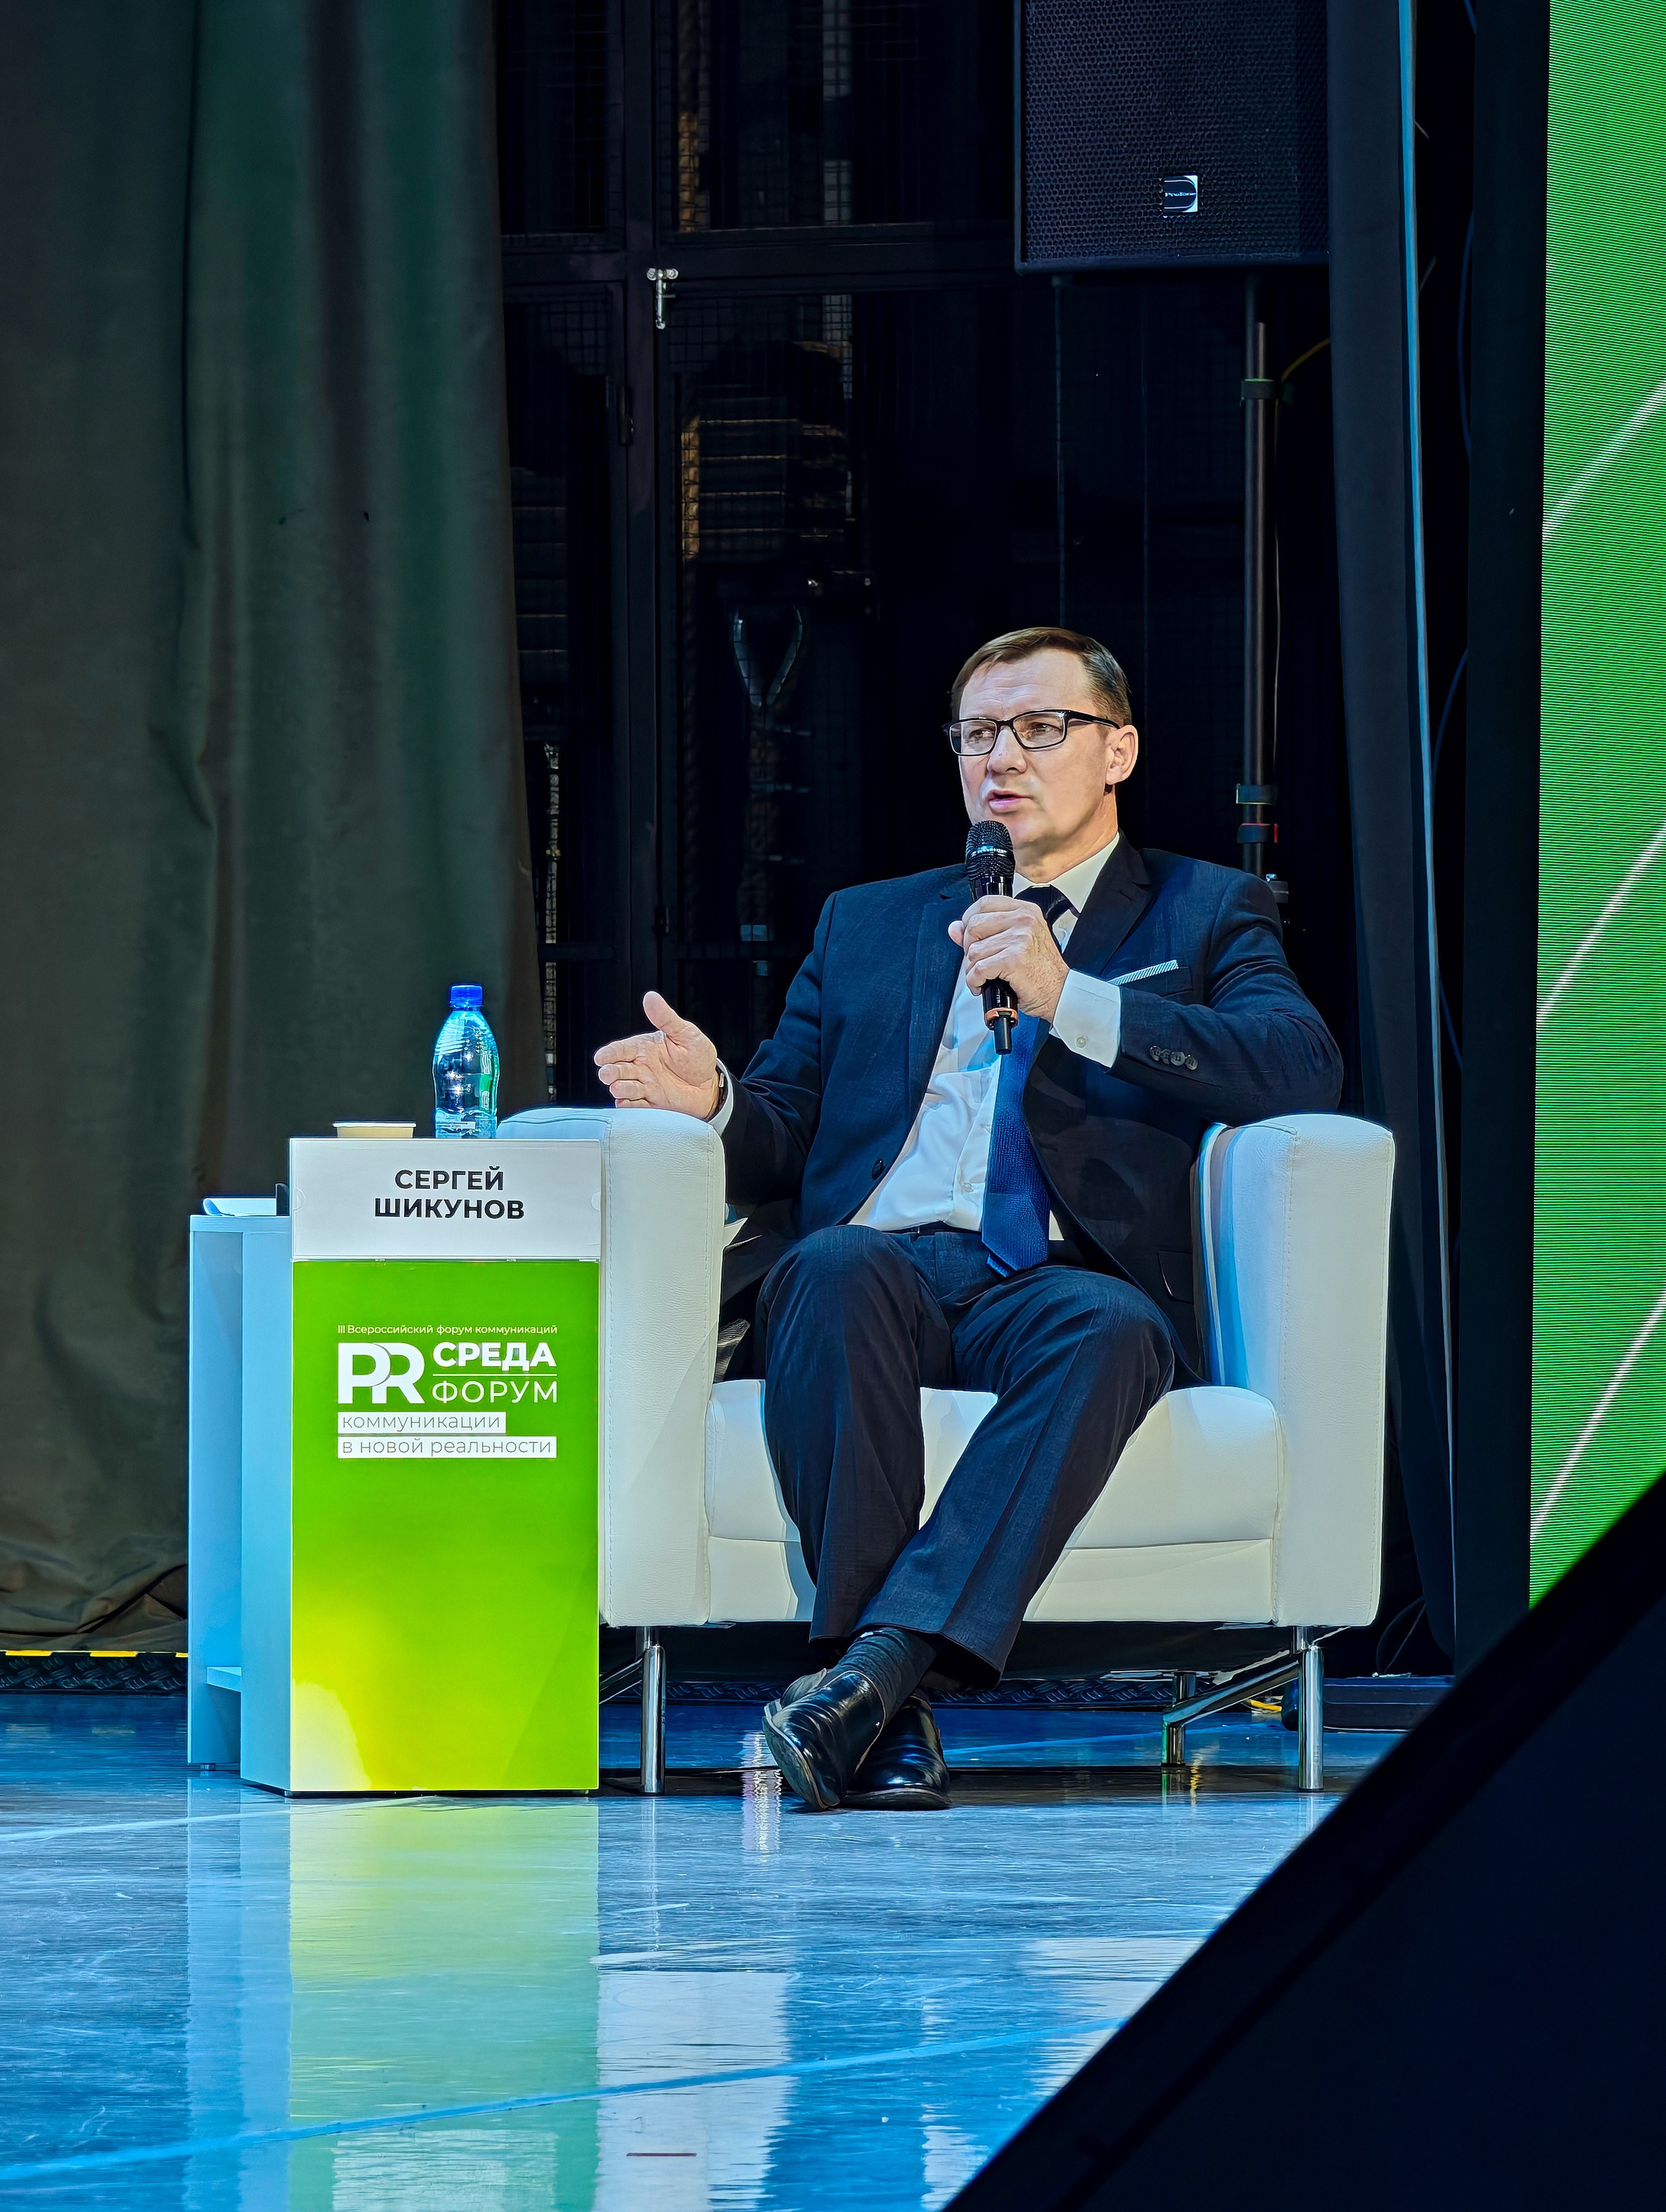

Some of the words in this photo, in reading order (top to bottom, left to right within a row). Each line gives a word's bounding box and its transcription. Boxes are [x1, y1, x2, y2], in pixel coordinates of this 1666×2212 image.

[395, 1166, 503, 1190] СЕРГЕЙ
[376, 1198, 524, 1219] ШИКУНОВ
[348, 1325, 433, 1335] Всероссийский
[436, 1325, 472, 1335] форум
[475, 1325, 558, 1335] коммуникаций
[338, 1342, 425, 1403] PR
[433, 1342, 556, 1371] СРЕДА
[433, 1380, 557, 1404] ФОРУМ
[343, 1416, 500, 1432] коммуникации
[344, 1442, 352, 1453] в
[361, 1438, 422, 1453] новой
[431, 1441, 551, 1457] реальности
